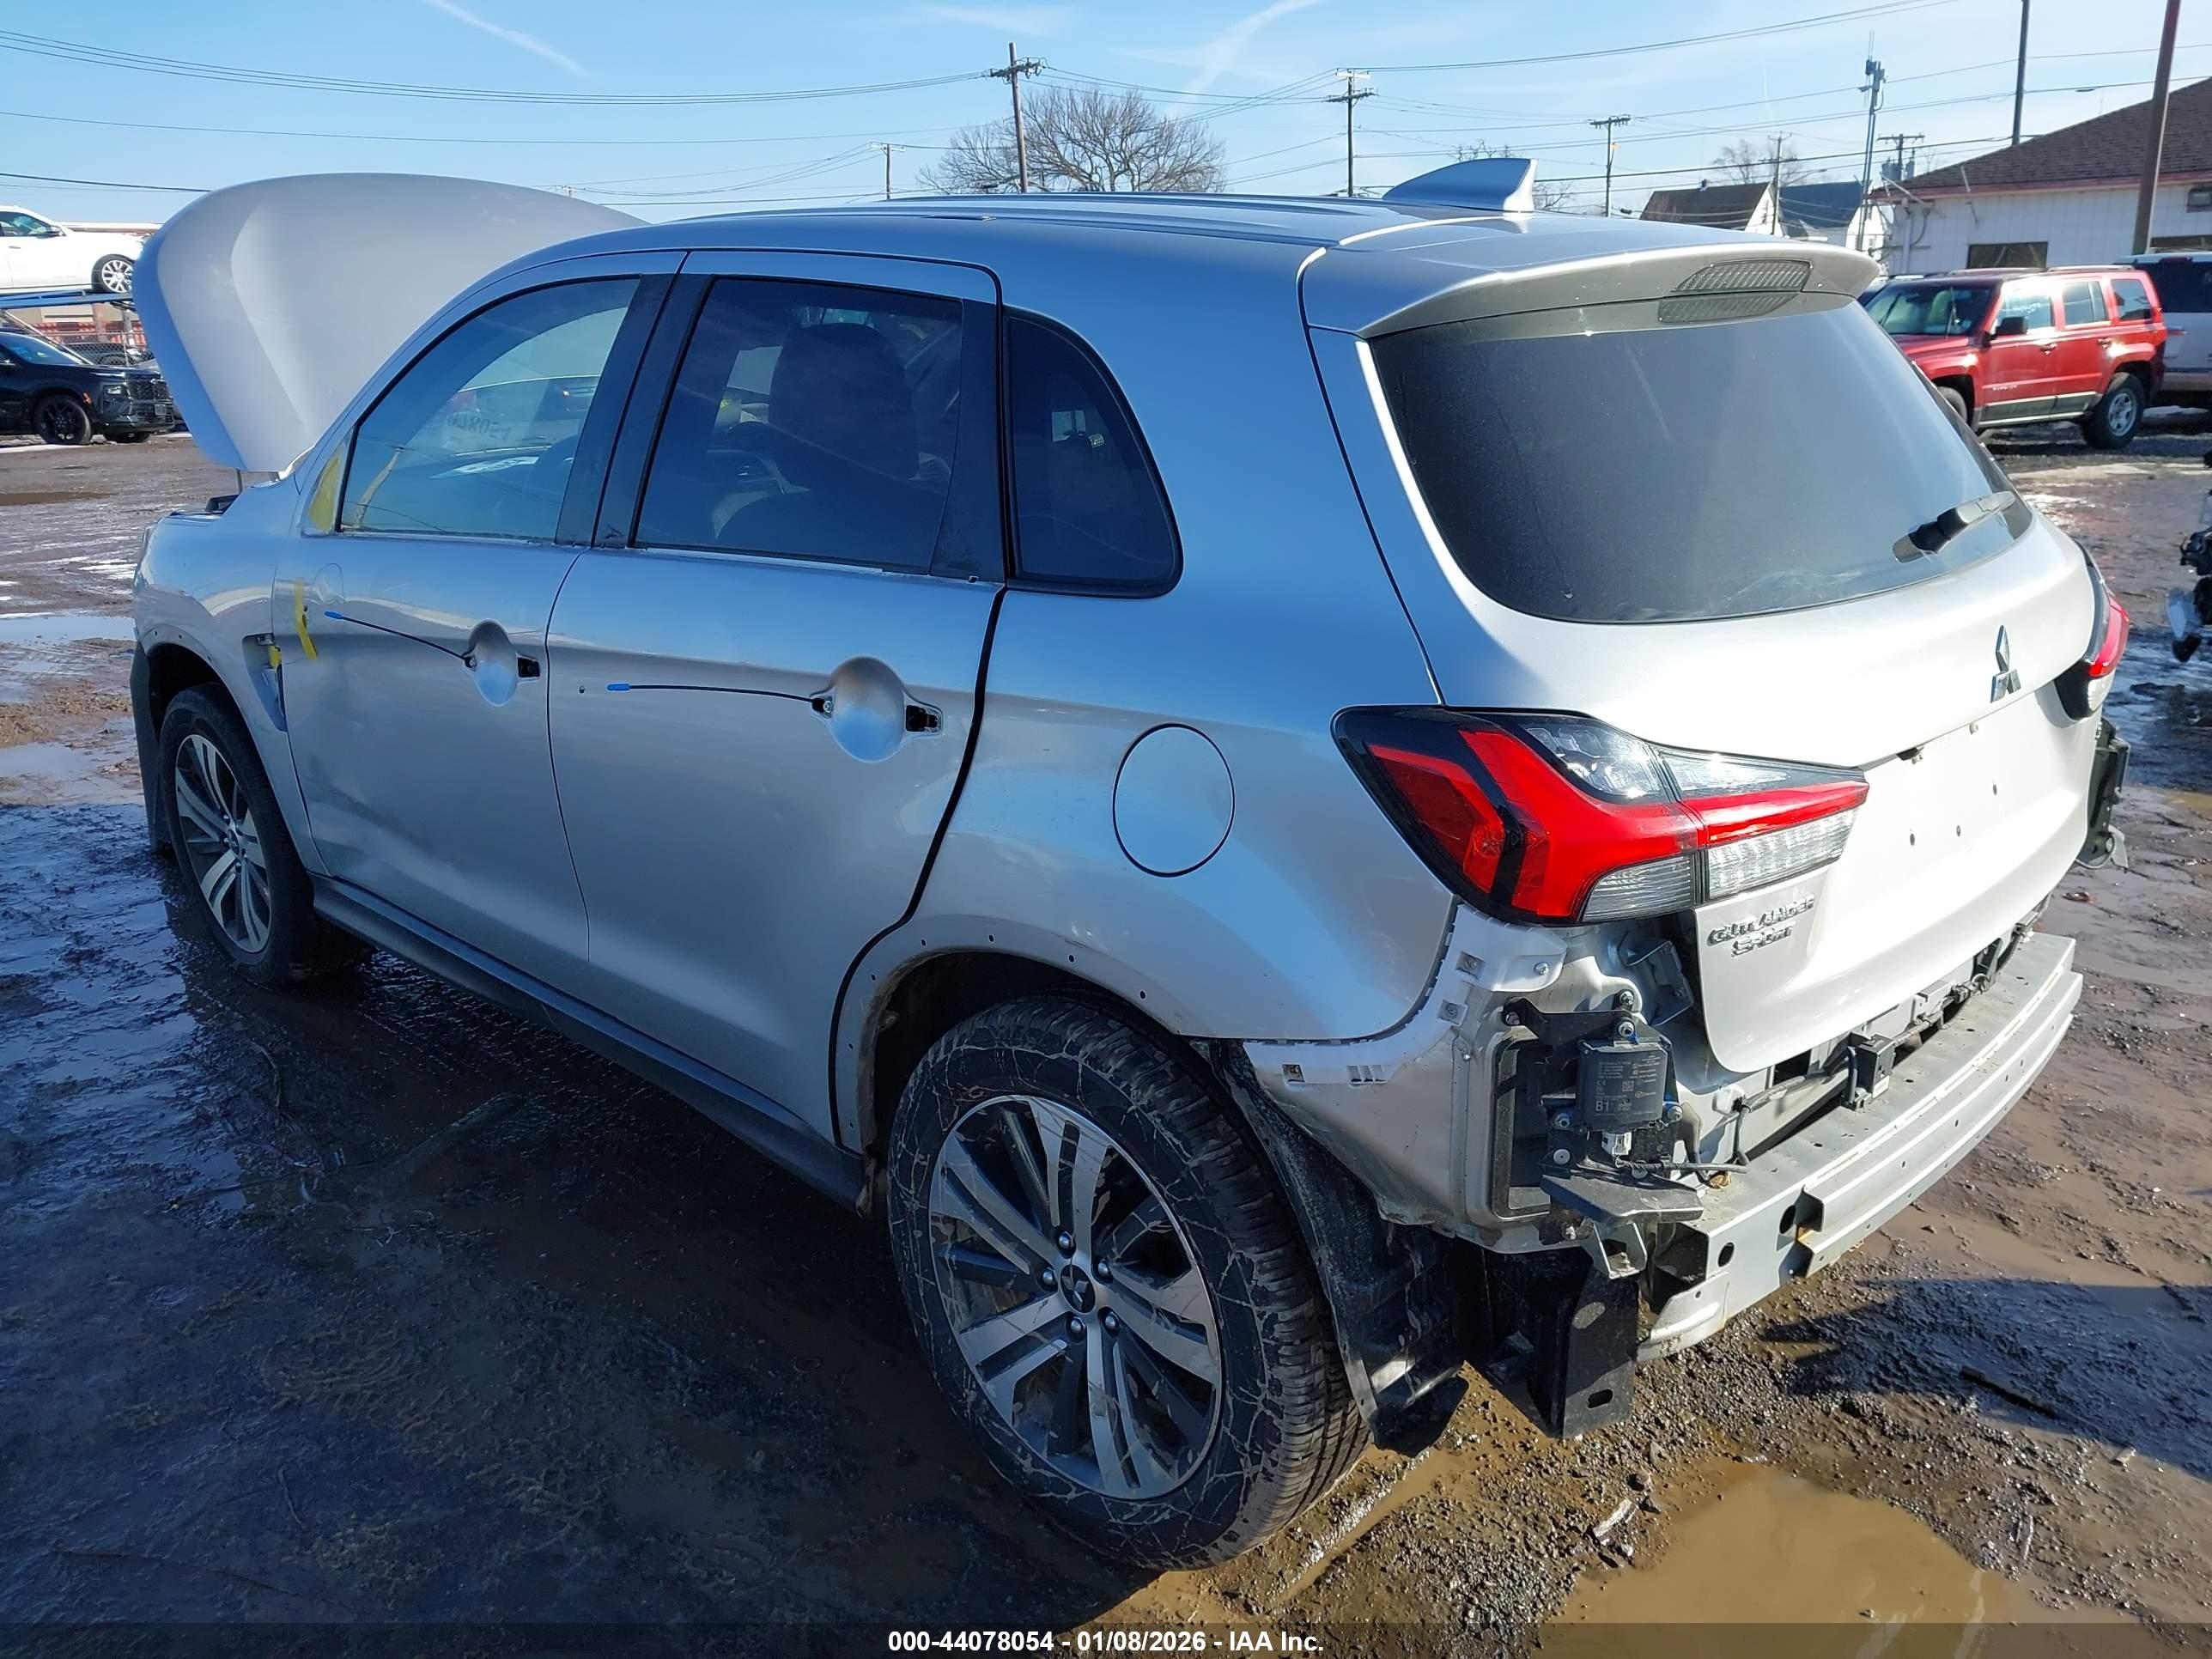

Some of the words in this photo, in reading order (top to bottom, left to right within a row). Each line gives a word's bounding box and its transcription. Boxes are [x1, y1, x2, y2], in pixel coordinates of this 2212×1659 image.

[1705, 895, 1814, 947] OUTLANDER
[1731, 922, 1796, 957] SPORT
[1595, 1100, 1609, 1111] B1
